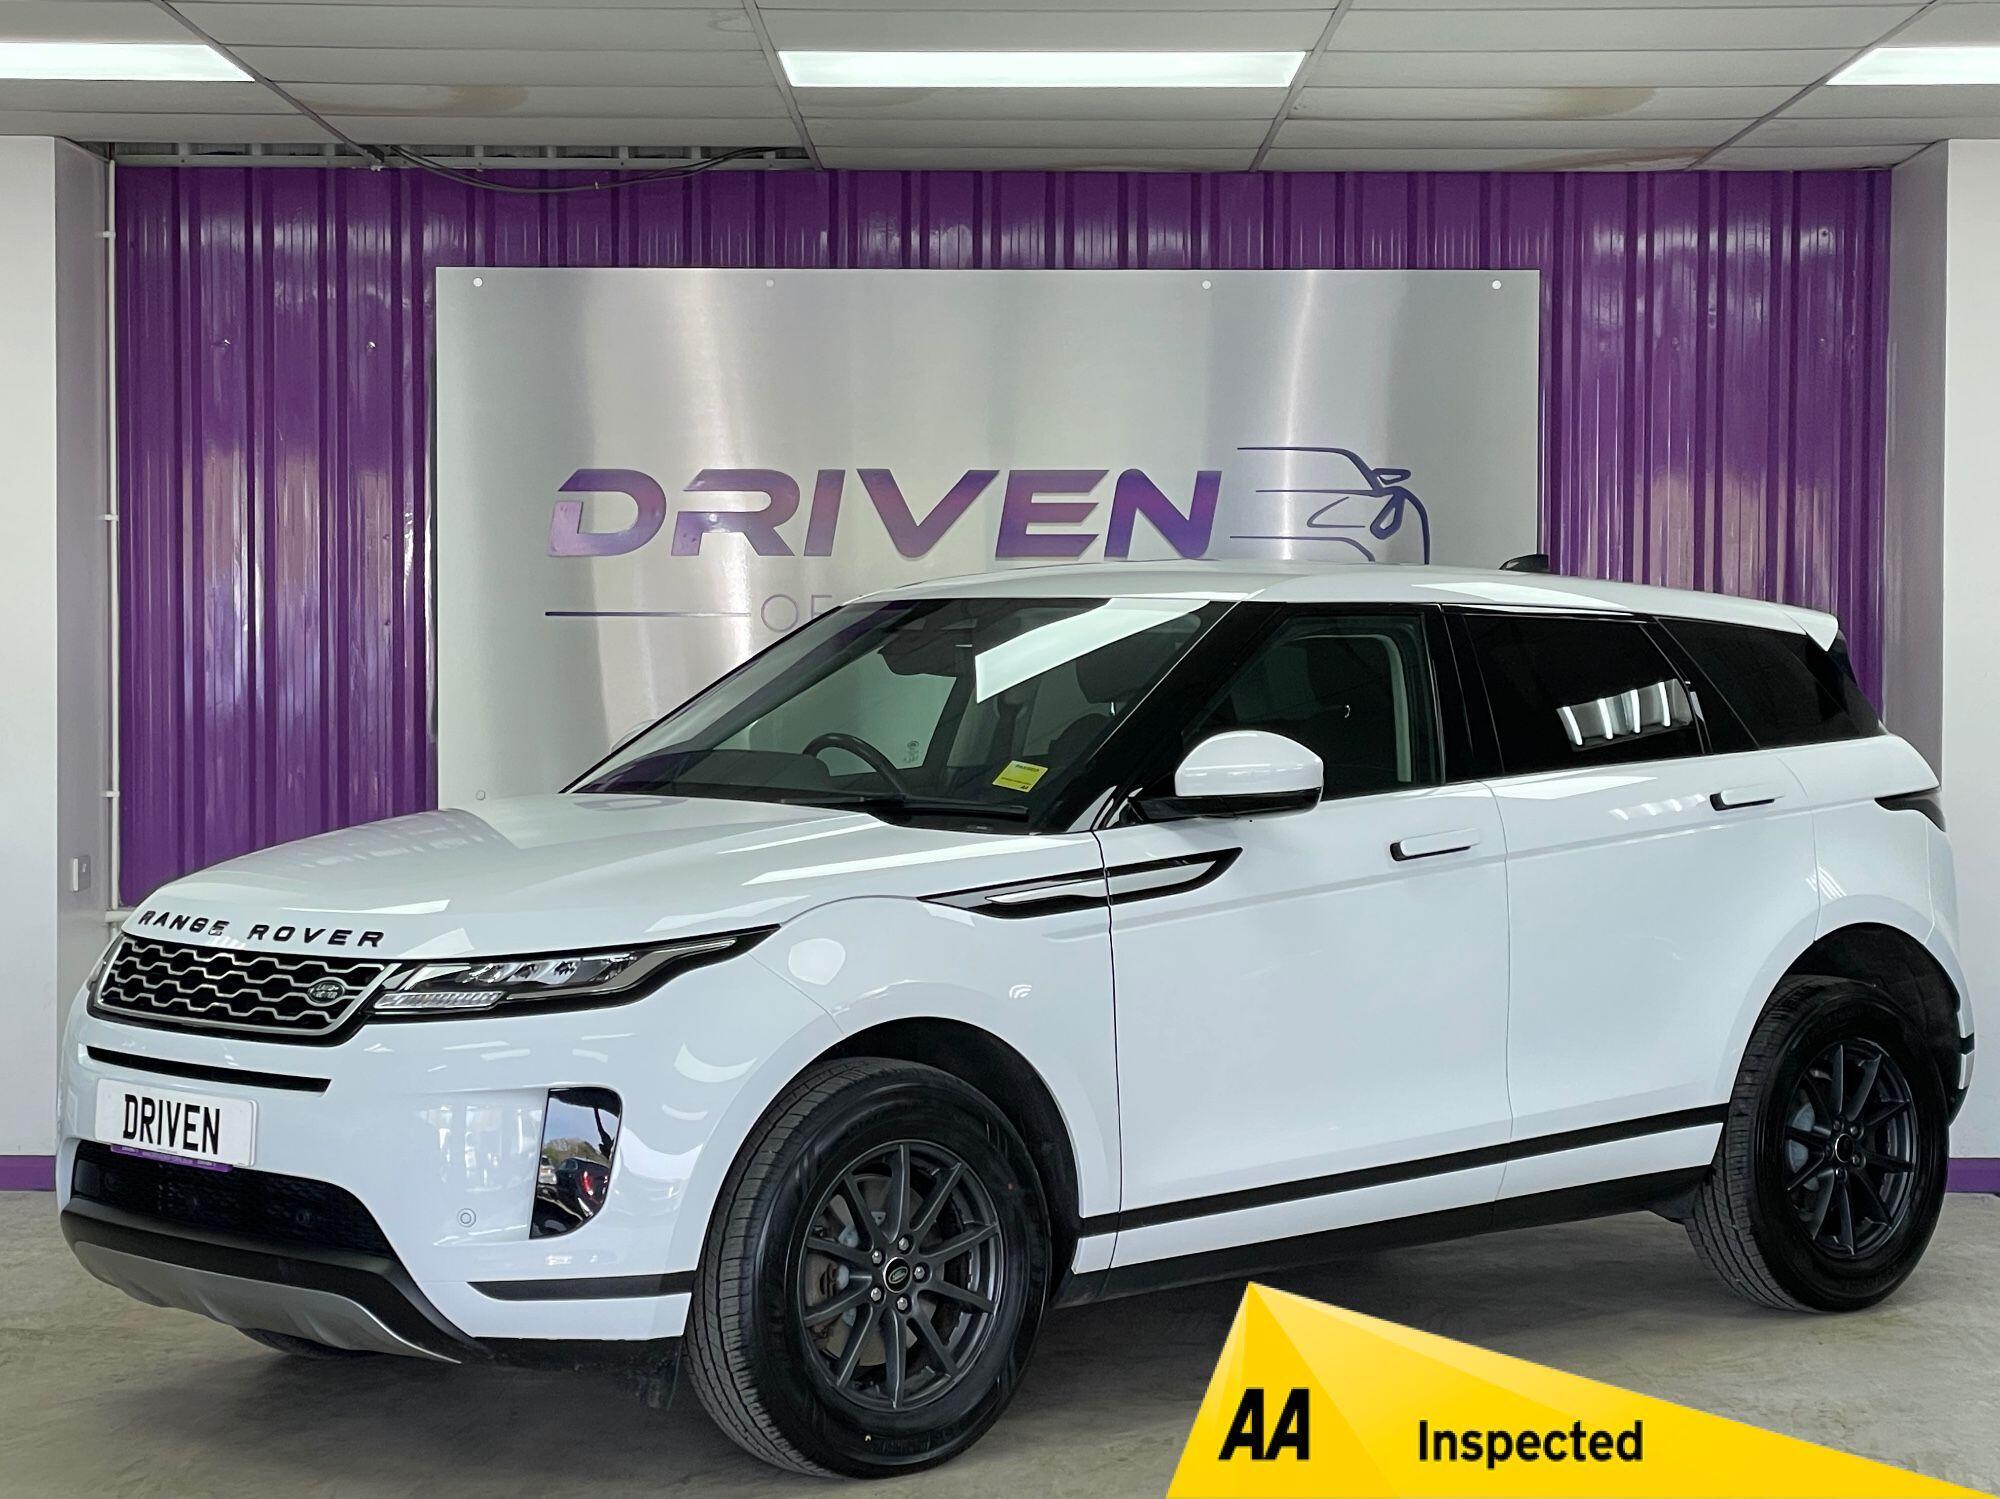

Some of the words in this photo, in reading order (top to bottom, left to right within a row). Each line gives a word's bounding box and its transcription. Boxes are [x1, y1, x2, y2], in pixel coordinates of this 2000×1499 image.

[547, 467, 1222, 560] DRIVEN
[138, 910, 230, 937] RANGE
[247, 923, 385, 948] ROVER
[123, 1093, 221, 1155] DRIVEN
